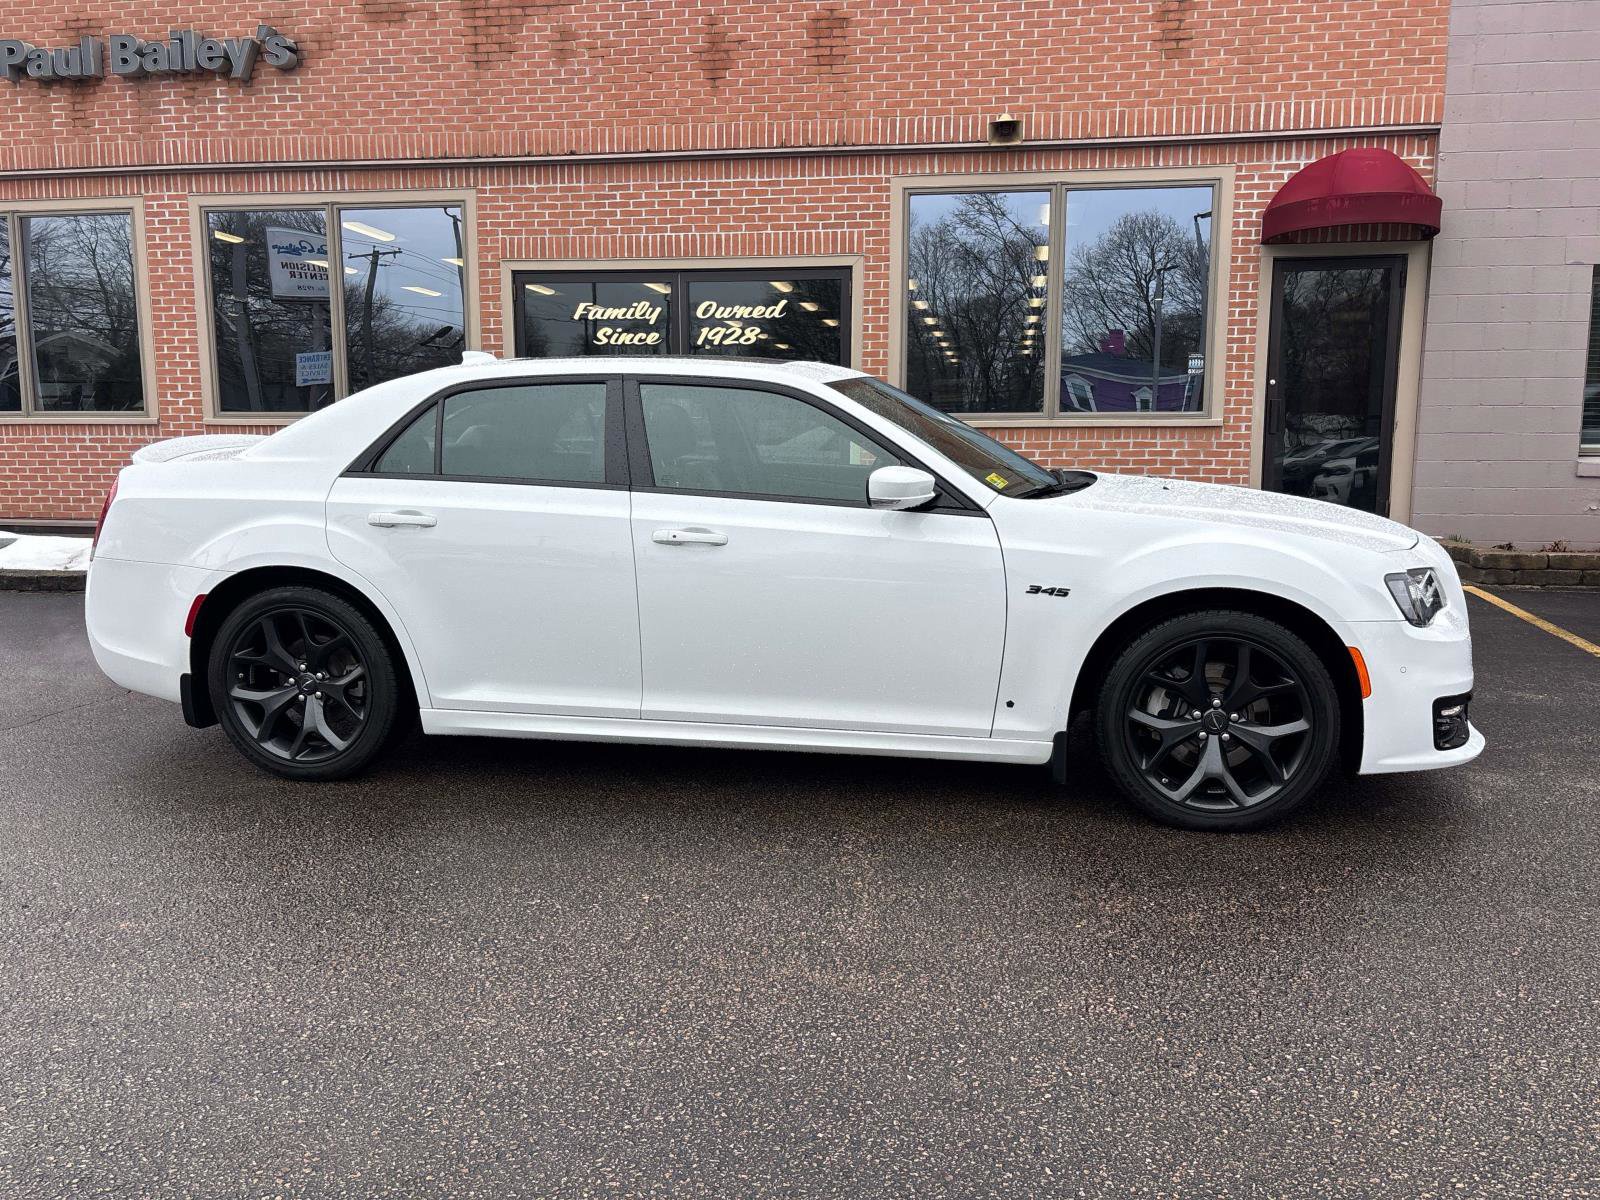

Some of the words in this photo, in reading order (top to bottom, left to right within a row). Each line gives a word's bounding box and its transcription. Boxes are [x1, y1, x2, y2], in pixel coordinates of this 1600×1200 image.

[0, 35, 102, 80] Paul
[110, 25, 298, 81] Bailey's
[573, 301, 662, 325] Family
[696, 300, 787, 320] Owned
[593, 327, 662, 346] Since
[698, 326, 761, 345] 1928
[1025, 585, 1071, 597] 345
